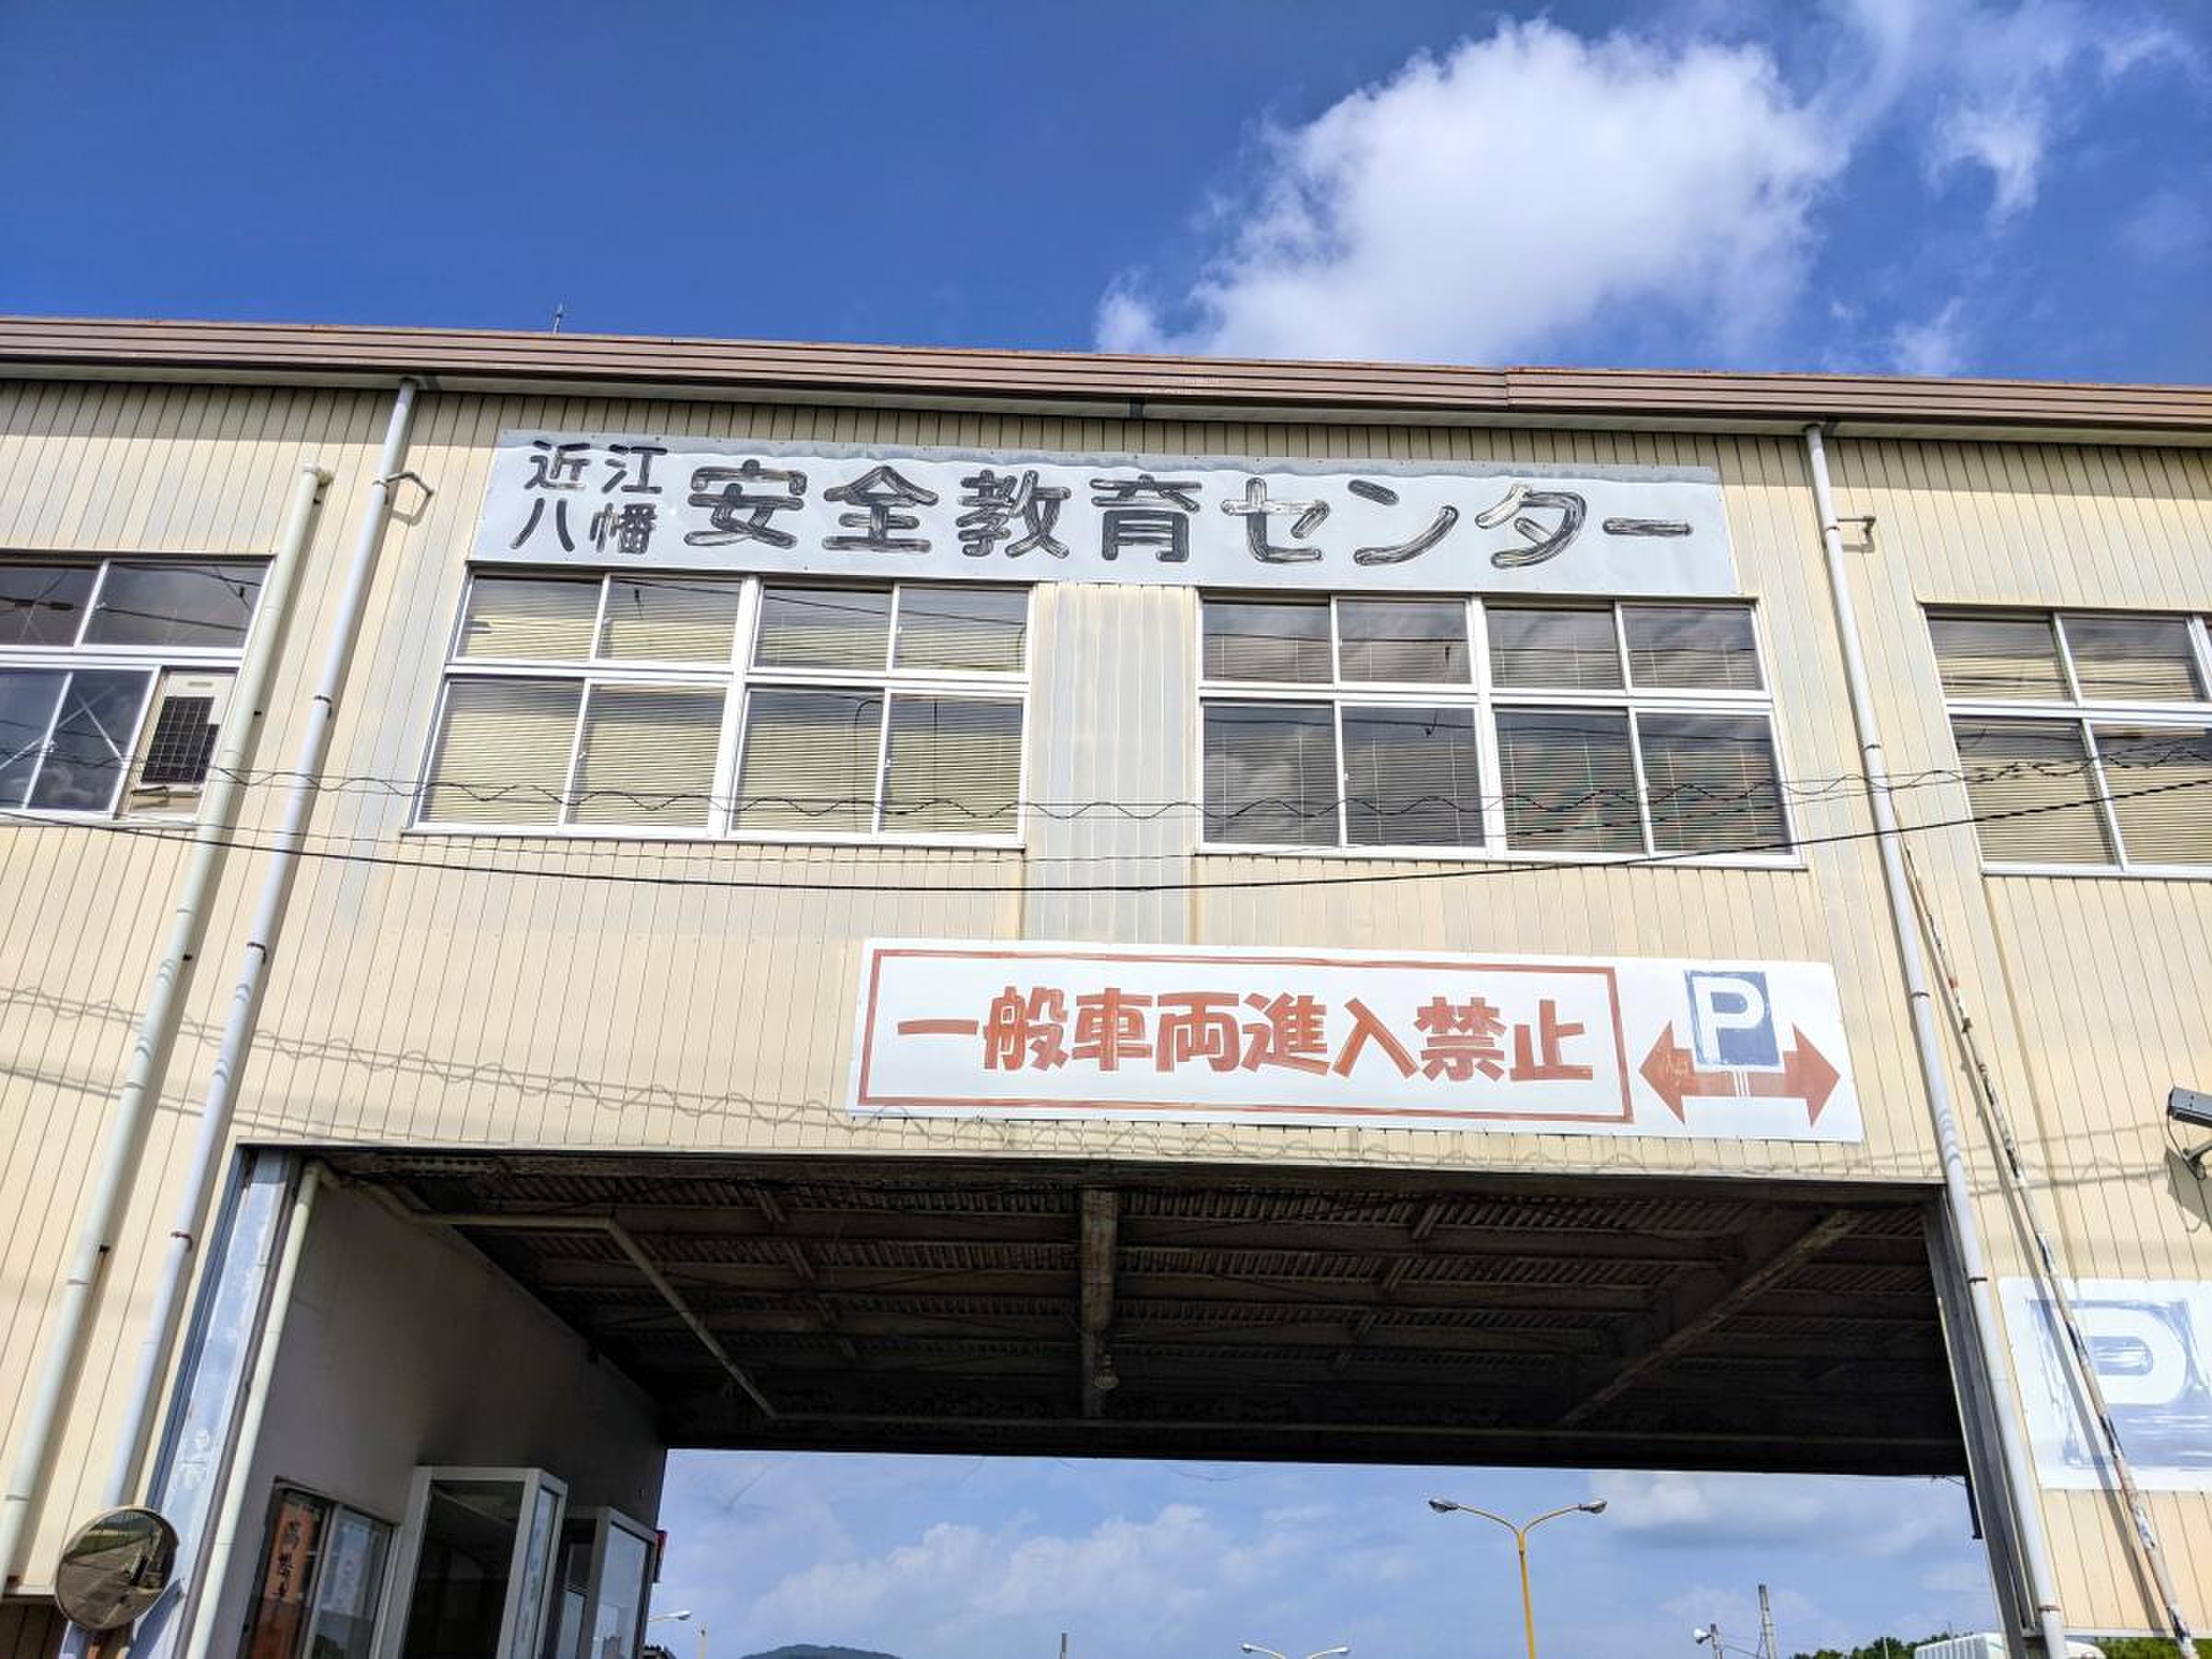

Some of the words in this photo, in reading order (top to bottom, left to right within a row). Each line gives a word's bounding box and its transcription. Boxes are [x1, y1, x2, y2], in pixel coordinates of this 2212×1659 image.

[524, 441, 668, 492] 近江
[513, 497, 657, 553] 八幡
[684, 459, 1692, 568] 安全教育センター
[897, 986, 1594, 1082] 一般車両進入禁止
[1692, 976, 1770, 1065] P
